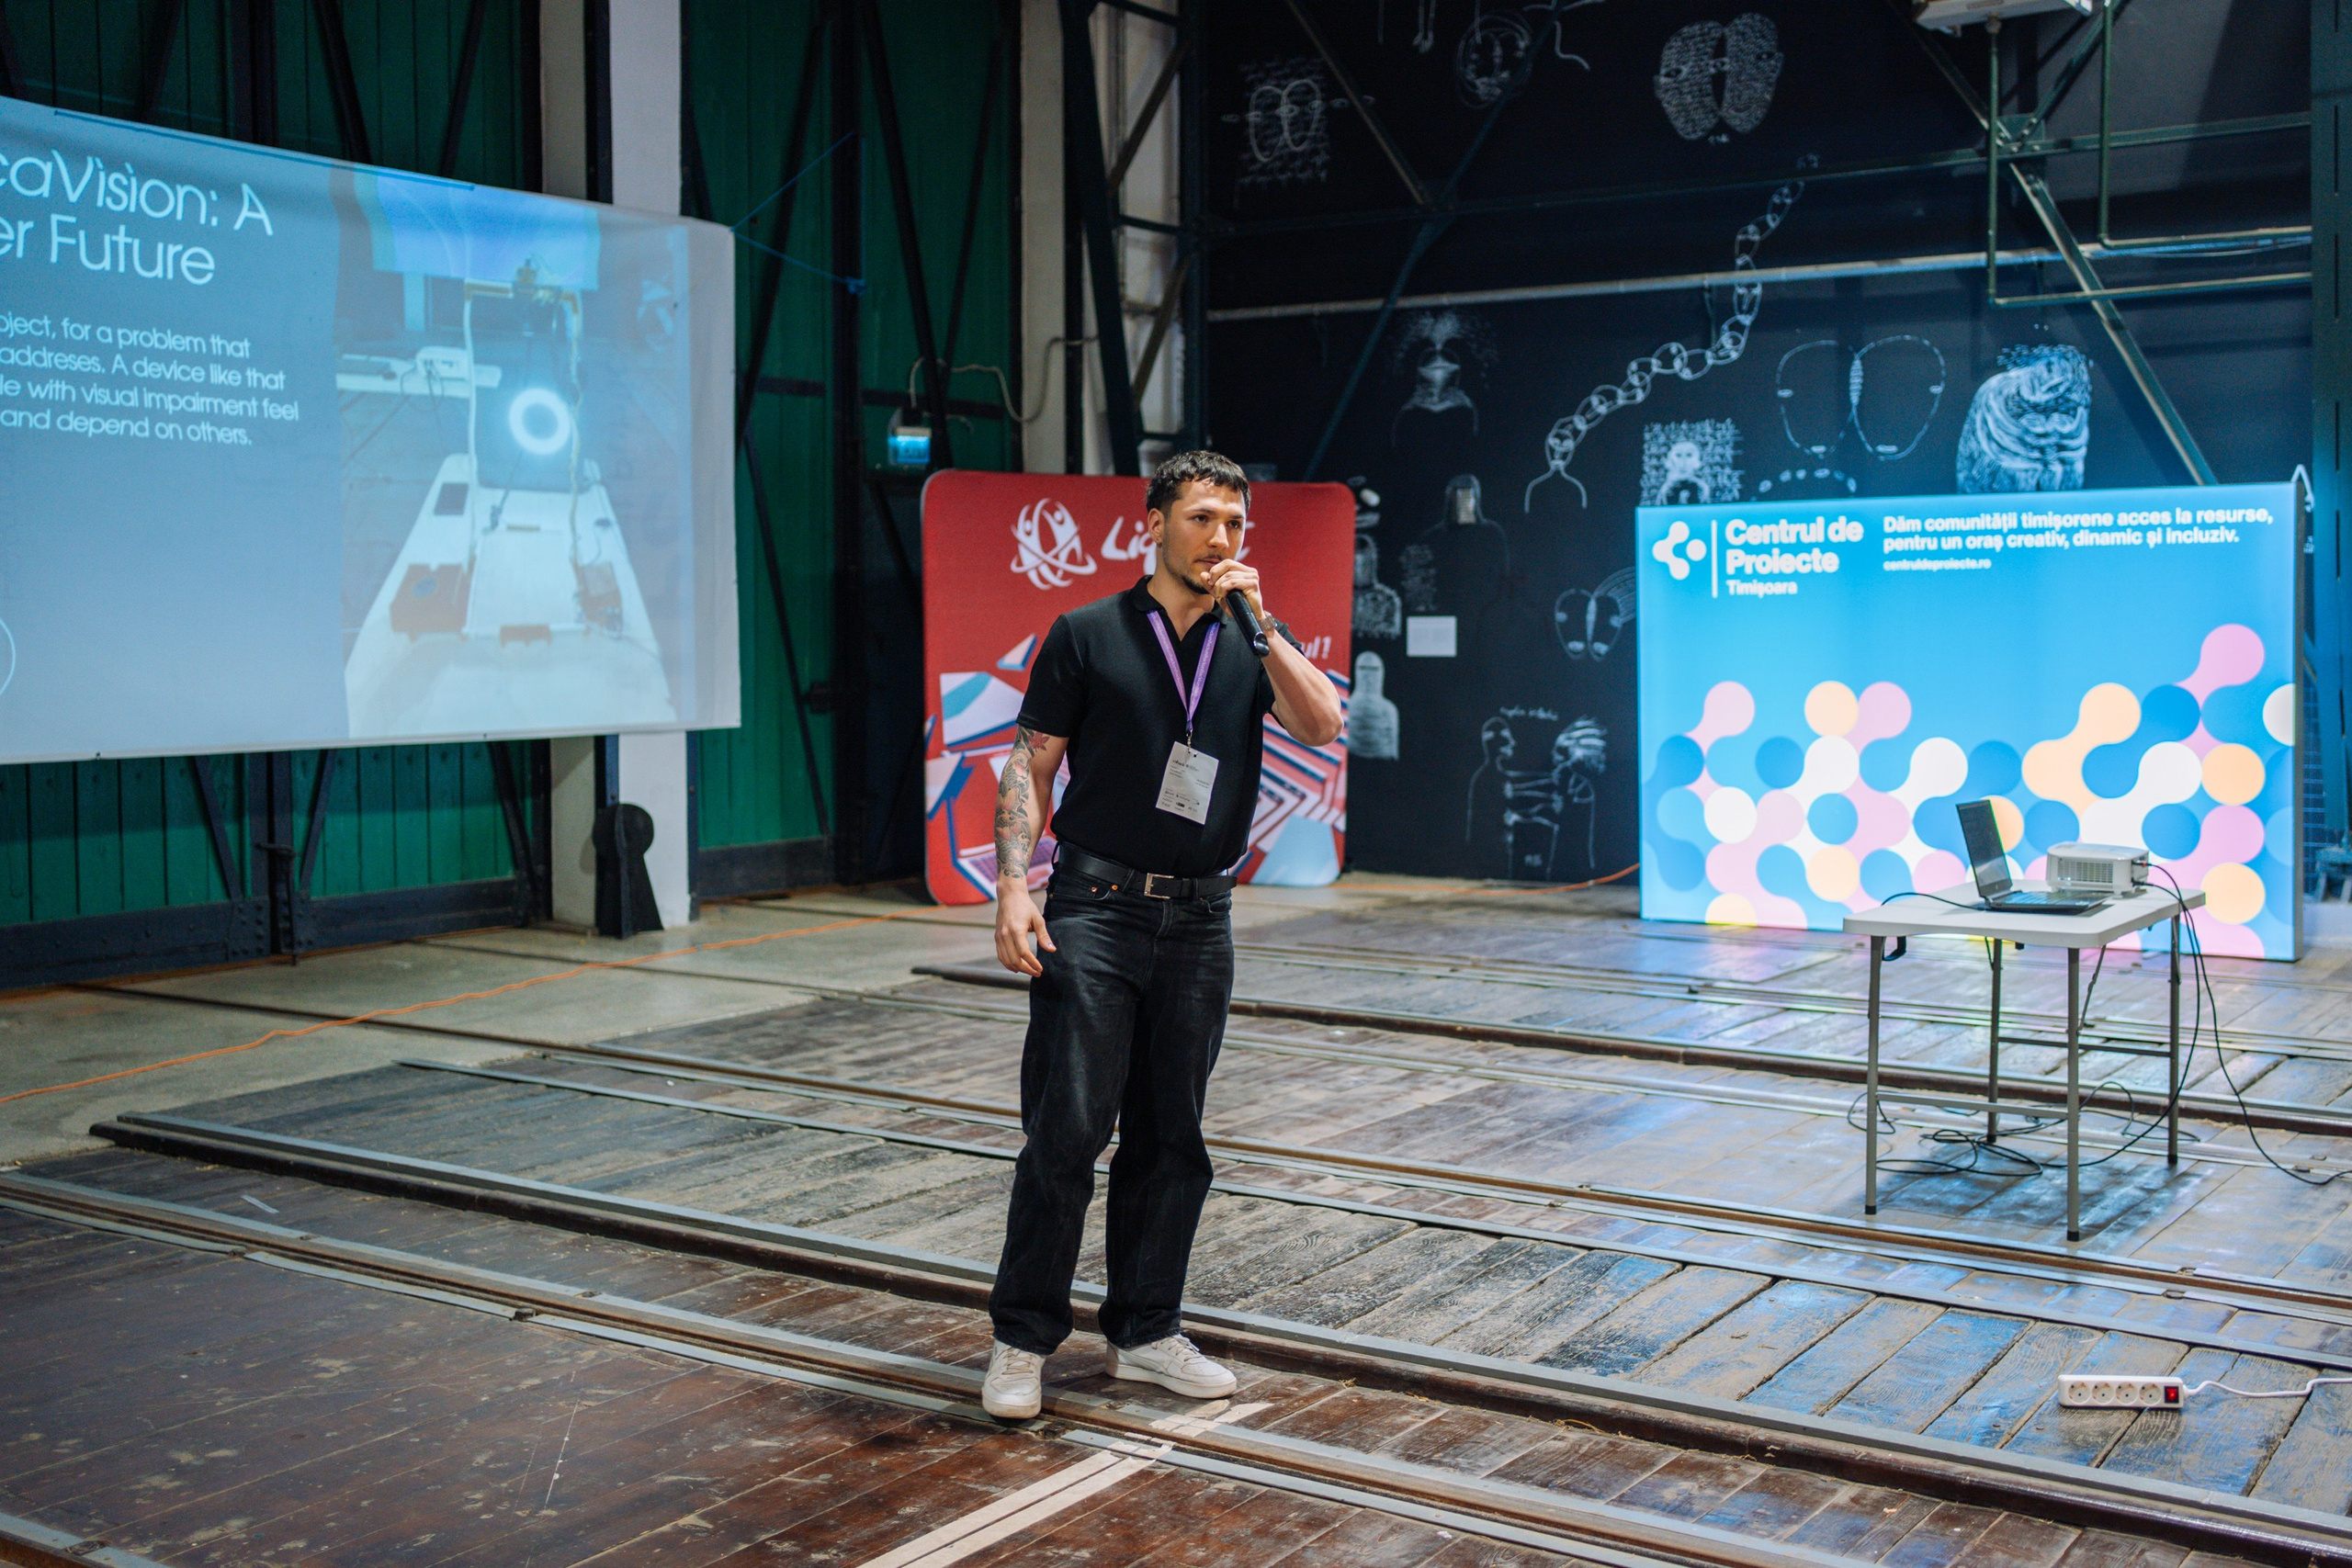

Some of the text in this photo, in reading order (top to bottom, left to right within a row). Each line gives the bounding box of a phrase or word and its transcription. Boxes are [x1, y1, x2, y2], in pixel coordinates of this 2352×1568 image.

[0, 149, 274, 236] aVision: A
[51, 213, 215, 286] Future
[61, 317, 91, 341] for
[96, 325, 112, 344] a
[117, 327, 207, 355] problem
[210, 333, 251, 359] that
[0, 344, 286, 391] addreses. A device like that
[28, 378, 76, 402] with
[81, 382, 139, 408] visual
[143, 387, 258, 418] impairment
[262, 397, 300, 422] feel
[0, 408, 253, 446] and depend on others.
[1724, 515, 1865, 546] Centrul de
[1883, 515, 1923, 534] Dăm
[2117, 511, 2173, 527] acces
[2175, 506, 2193, 525] la
[2196, 507, 2274, 526] resurse,
[1883, 525, 2241, 555] pentru un oraș creativ, dinamic și incluziv.
[1724, 547, 1840, 576] Proiecte
[1725, 579, 1798, 599] Timișoara
